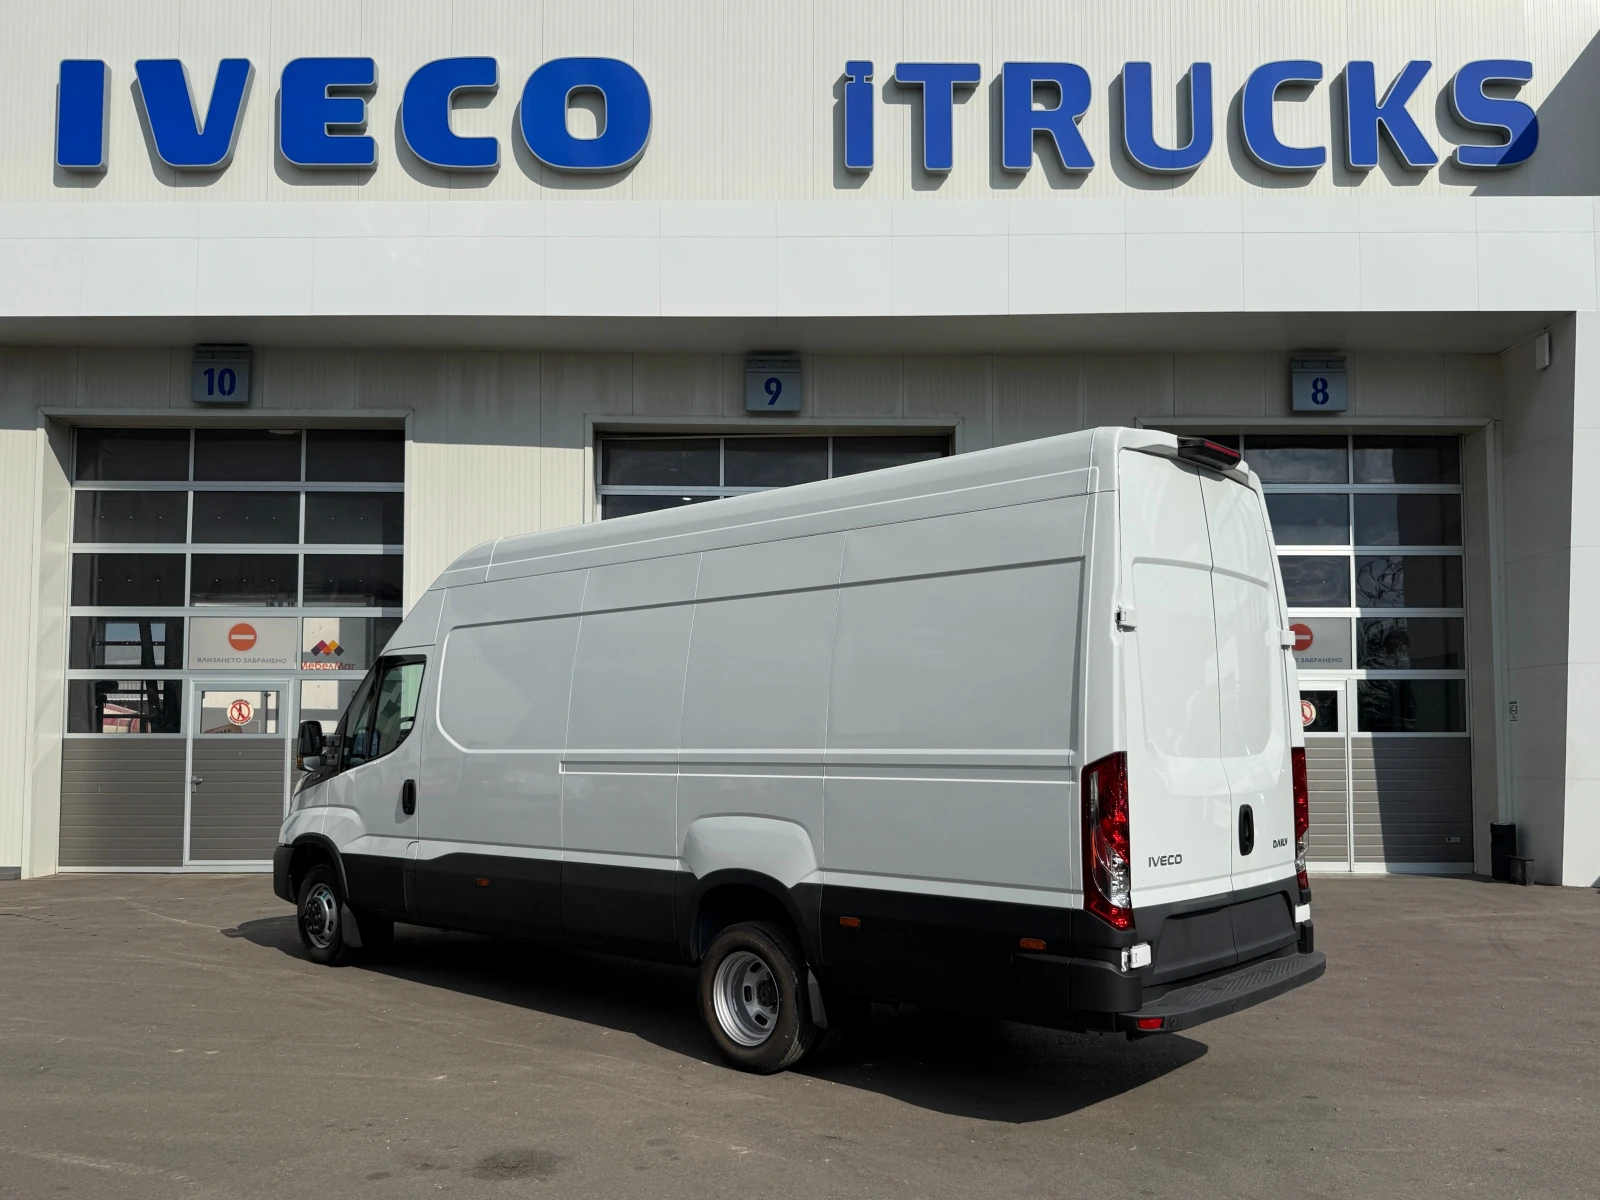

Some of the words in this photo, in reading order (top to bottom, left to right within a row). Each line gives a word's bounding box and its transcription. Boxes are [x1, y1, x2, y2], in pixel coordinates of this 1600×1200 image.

[56, 56, 653, 170] IVECO
[843, 59, 1539, 172] iTRUCKS
[203, 367, 236, 397] 10
[764, 377, 783, 406] 9
[1311, 377, 1329, 405] 8
[1272, 837, 1288, 848] DAILY
[1148, 853, 1183, 868] IVECO
